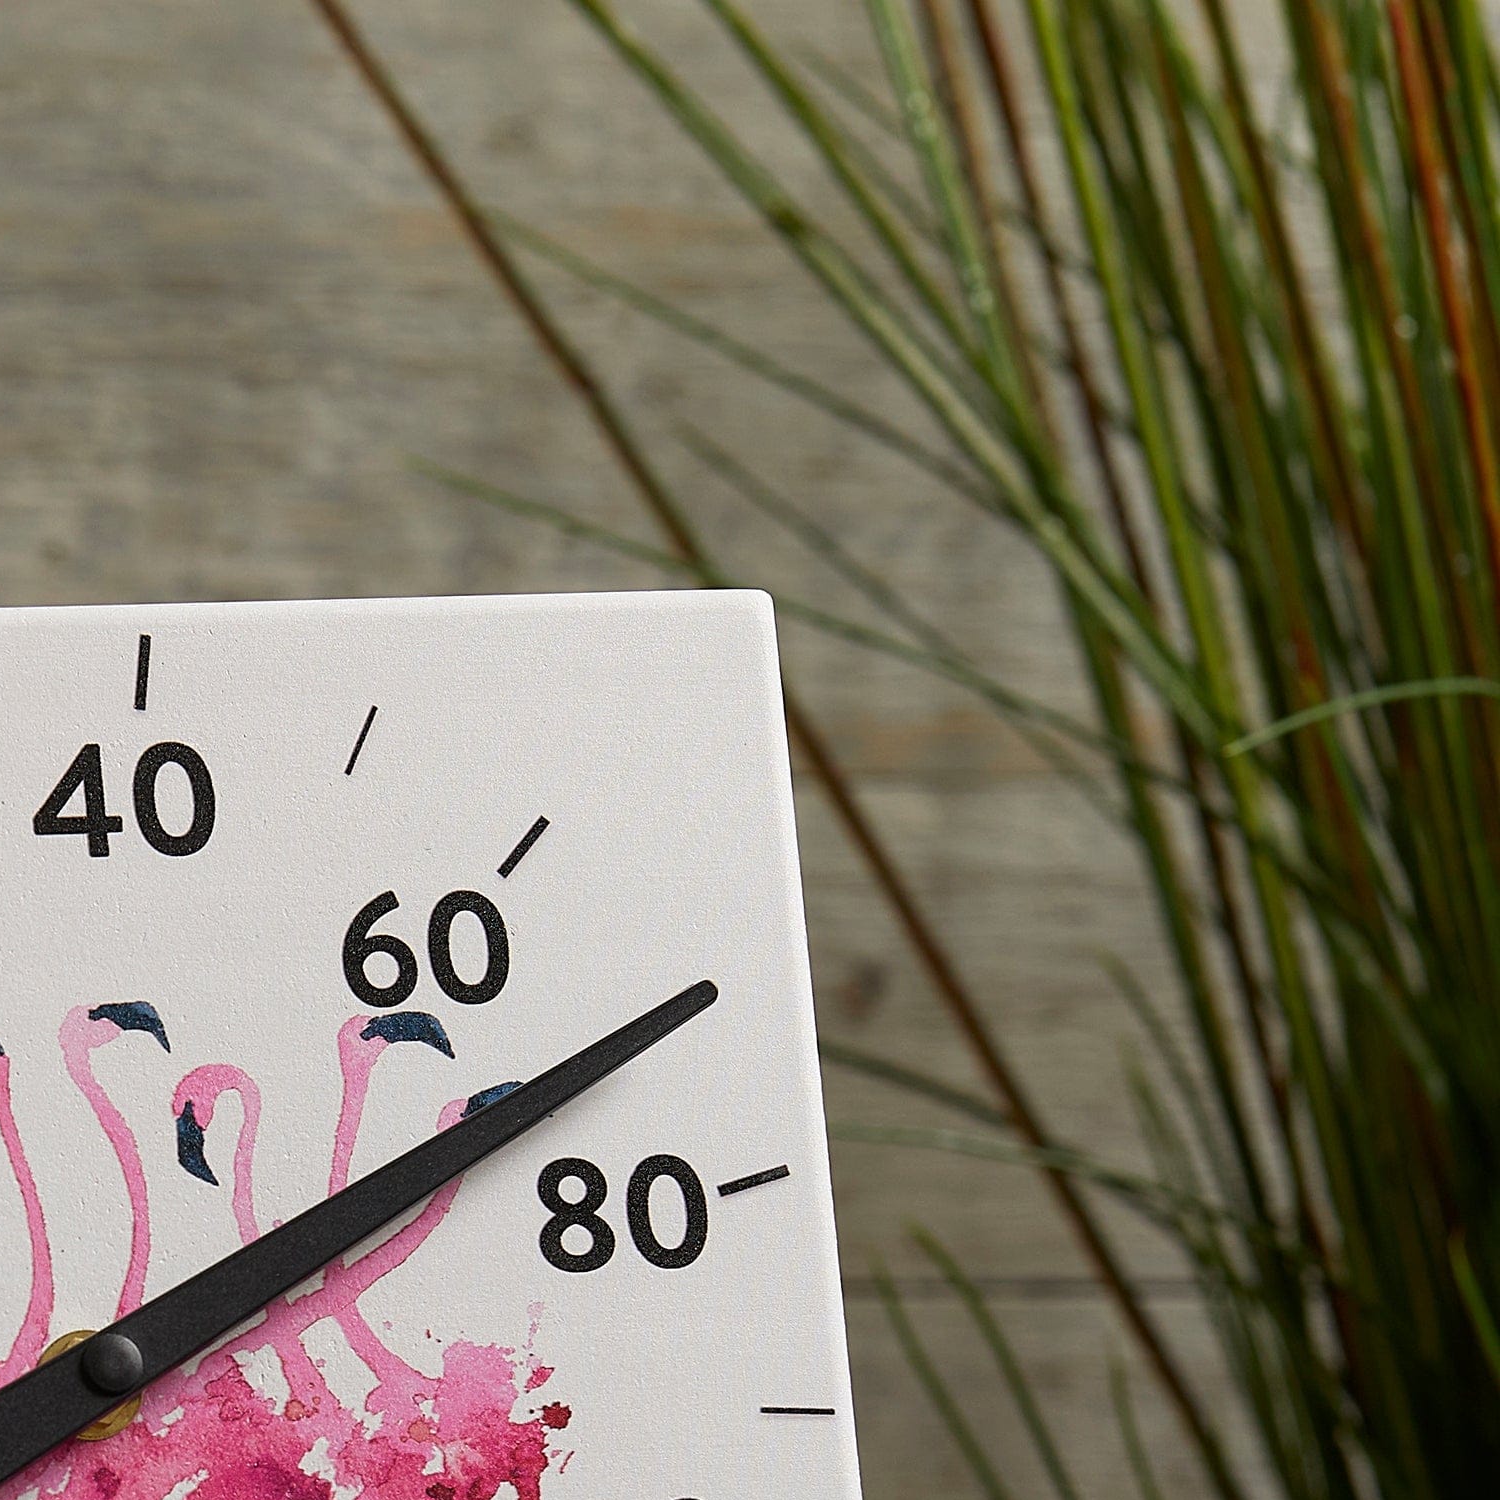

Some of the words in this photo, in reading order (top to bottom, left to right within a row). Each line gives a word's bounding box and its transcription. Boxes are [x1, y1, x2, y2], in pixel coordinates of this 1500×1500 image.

[32, 741, 216, 858] 40
[342, 890, 510, 1008] 60
[537, 1154, 708, 1273] 80
